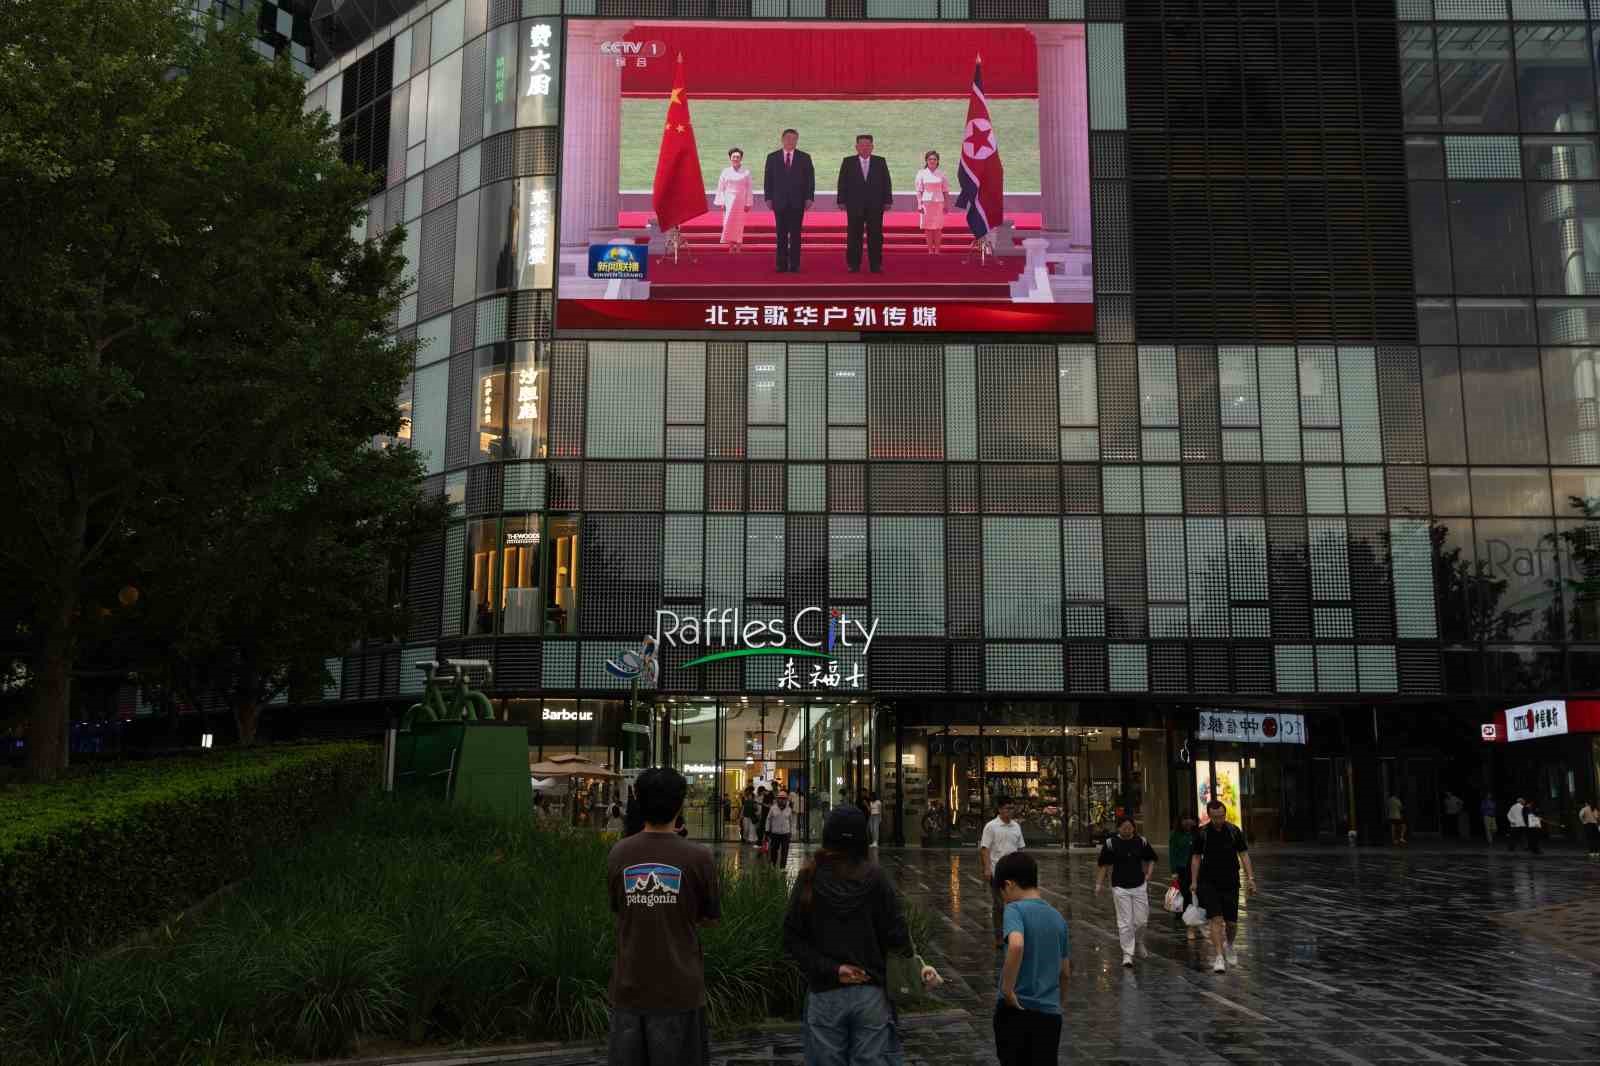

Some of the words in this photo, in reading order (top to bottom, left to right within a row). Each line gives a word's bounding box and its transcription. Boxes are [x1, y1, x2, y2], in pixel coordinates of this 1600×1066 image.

[600, 40, 643, 54] CCTV
[704, 305, 937, 327] 北京歌华户外传媒
[656, 607, 787, 648] Raffles
[793, 606, 879, 655] City
[778, 657, 866, 689] 来福士
[542, 708, 593, 721] Barbour
[626, 893, 677, 907] patagonia
